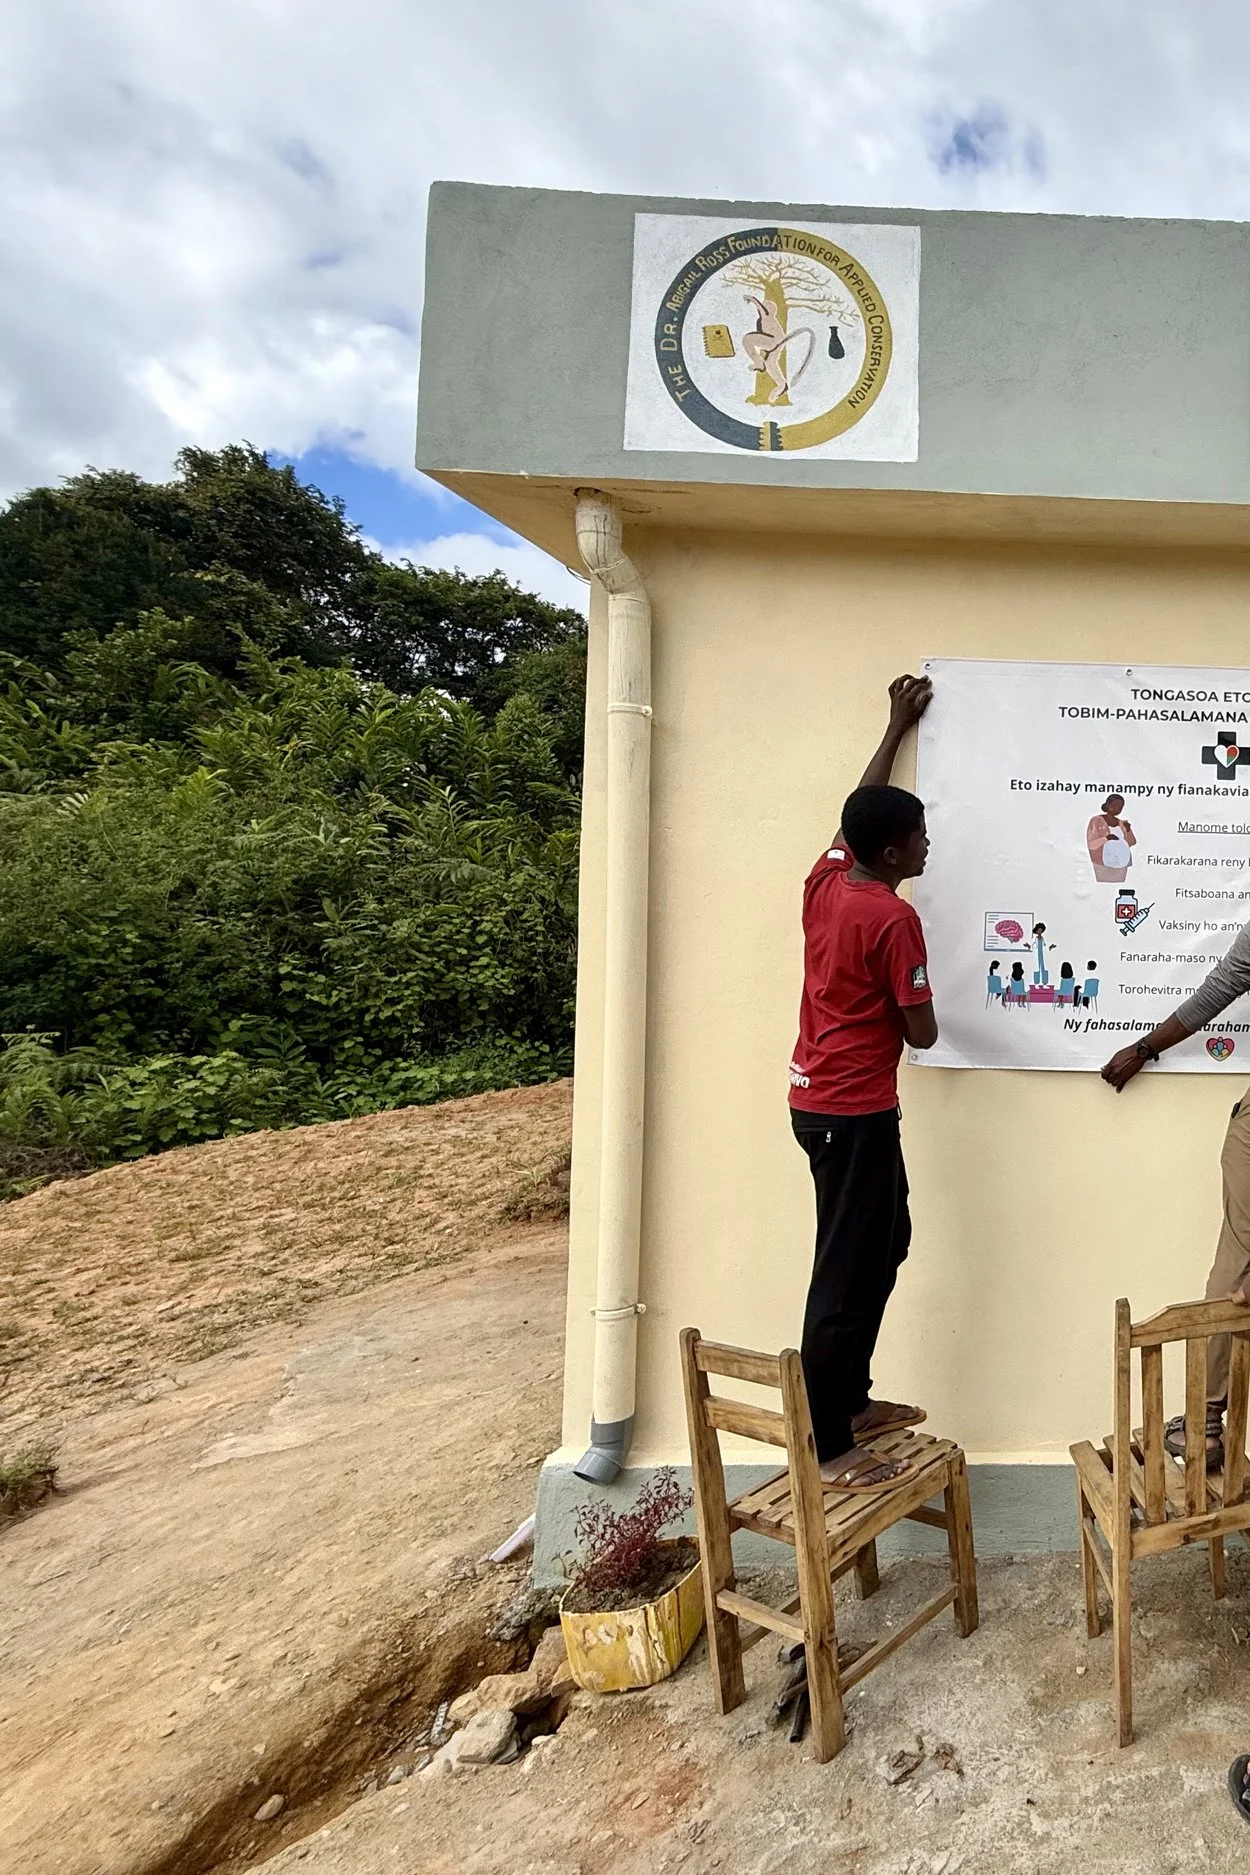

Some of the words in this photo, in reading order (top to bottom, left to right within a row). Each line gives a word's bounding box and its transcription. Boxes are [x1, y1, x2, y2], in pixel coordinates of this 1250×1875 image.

[727, 234, 816, 256] FOUNDATION
[695, 246, 730, 274] ROSS
[816, 247, 841, 267] FOR
[666, 270, 701, 312] ABIGAIL
[839, 263, 877, 313] APPLIED
[848, 315, 885, 409] CONSERVATION
[668, 364, 691, 401] THE
[1131, 688, 1218, 703] TONGASOA
[1058, 706, 1248, 724] TOBIM-PAHASALAMANA
[1010, 779, 1032, 791] Eto
[1036, 779, 1081, 796] izahay
[1085, 783, 1154, 799] manampy
[1157, 785, 1175, 798] ny
[1178, 821, 1228, 834] Manome
[1147, 855, 1218, 867] Fikarakarana
[1221, 858, 1245, 870] reny
[1175, 888, 1235, 899] Fitsaboana
[1159, 920, 1201, 933] Vaksiny
[1204, 920, 1218, 931] ho
[1120, 951, 1206, 963] Fanaraha-maso
[1118, 983, 1182, 996] Torohevitra
[1063, 1018, 1082, 1033] Ny
